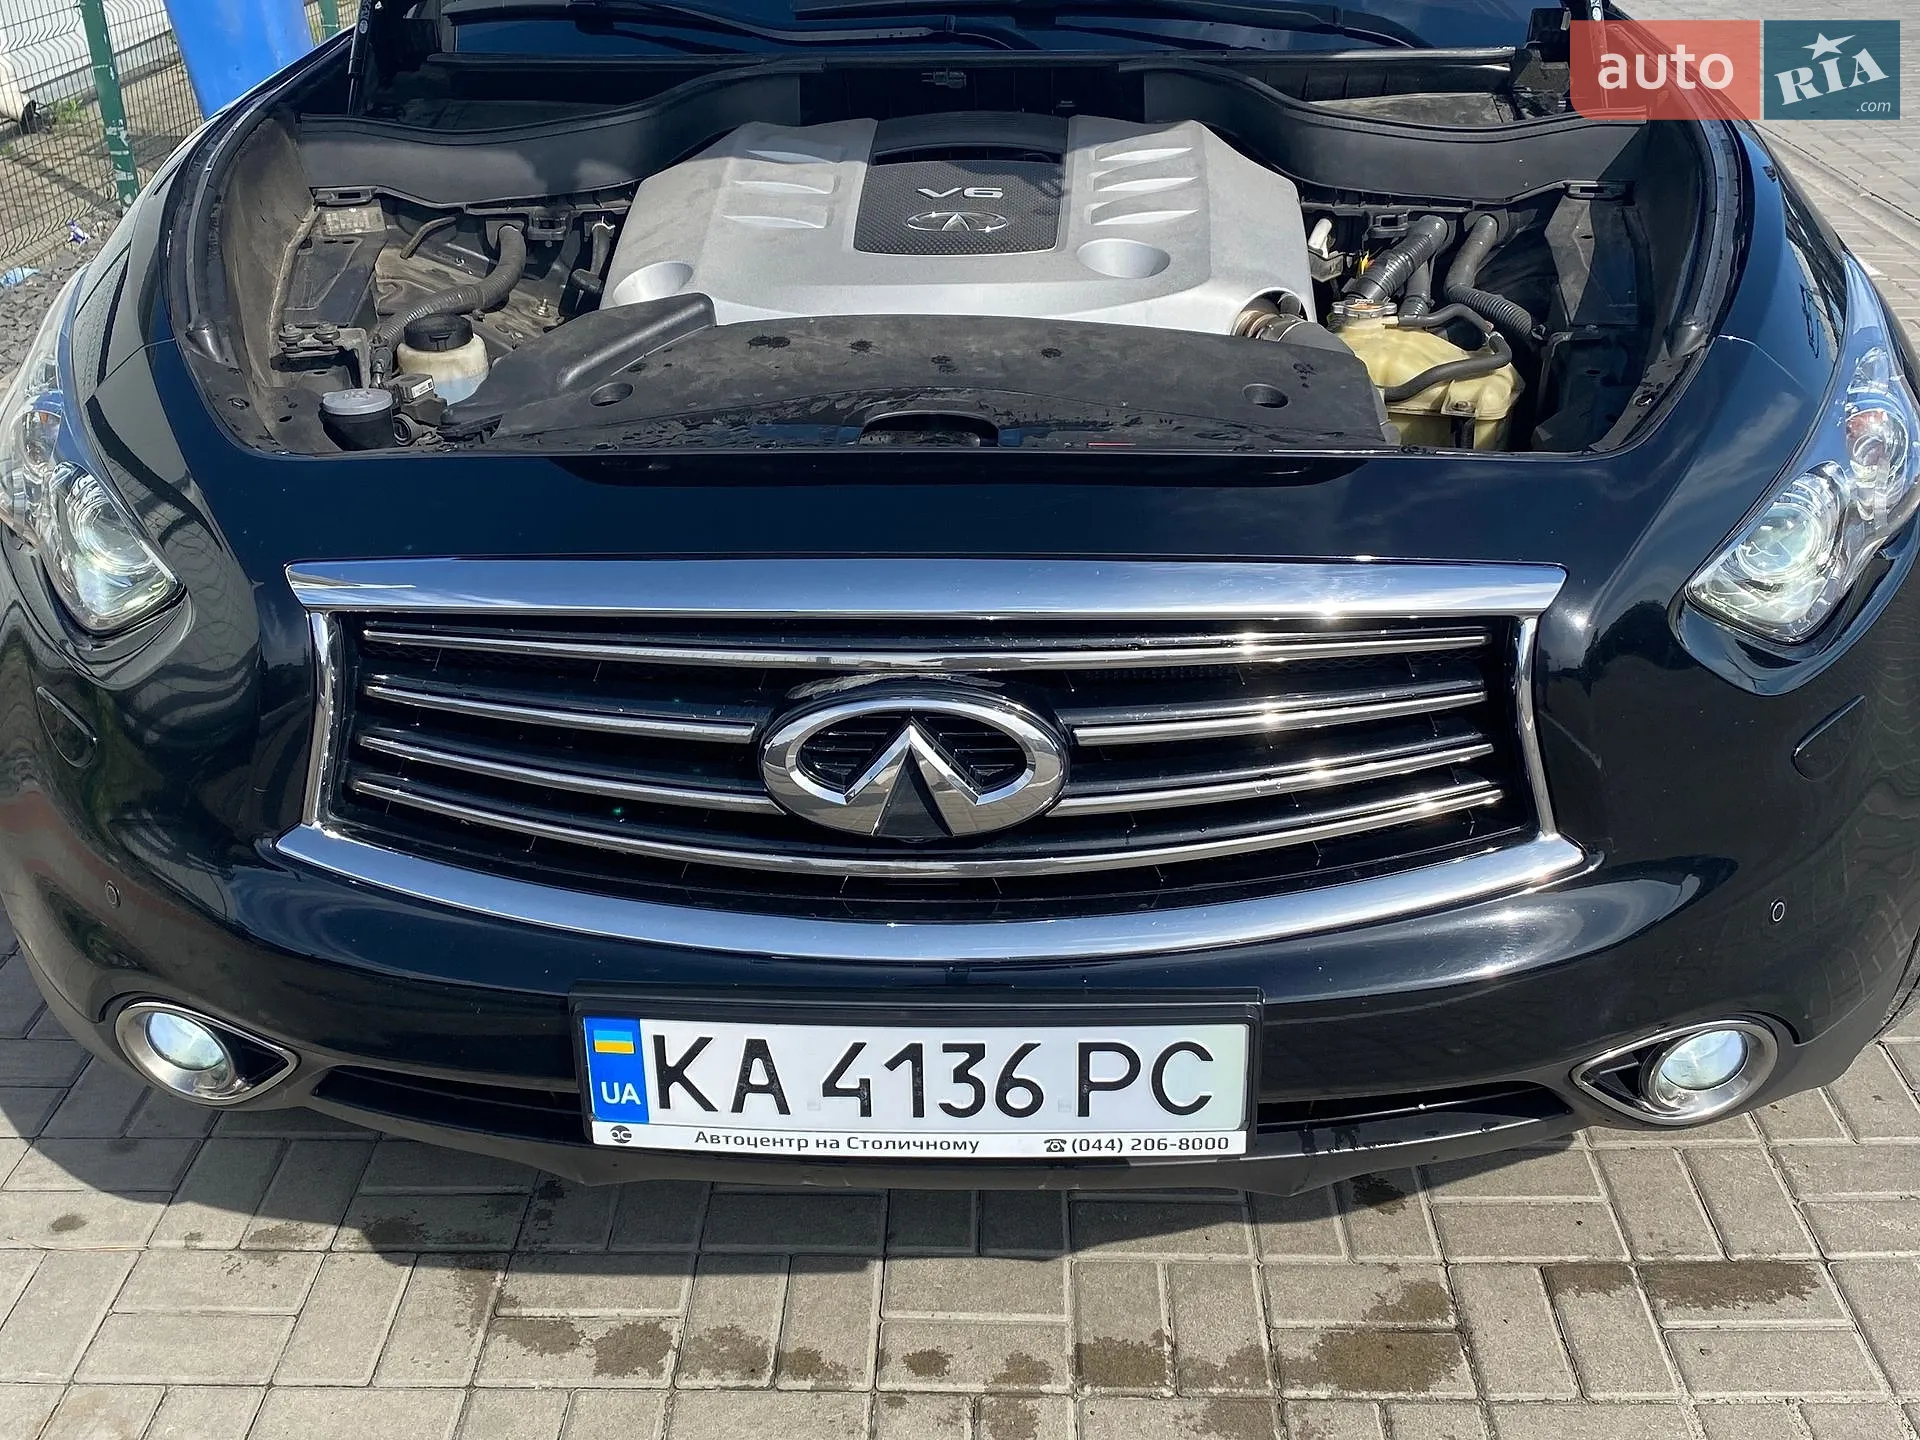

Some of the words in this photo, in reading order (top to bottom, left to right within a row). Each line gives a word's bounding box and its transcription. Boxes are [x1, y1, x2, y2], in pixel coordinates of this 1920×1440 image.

[917, 187, 1004, 198] V6
[652, 1034, 791, 1116] KA
[821, 1041, 1045, 1119] 4136
[1077, 1040, 1214, 1118] PC
[600, 1081, 641, 1105] UA
[695, 1130, 809, 1152] Автоцентр
[815, 1138, 840, 1149] на
[846, 1136, 980, 1154] Столичному
[1071, 1138, 1124, 1153] (044)
[1130, 1137, 1229, 1151] 206-8000
